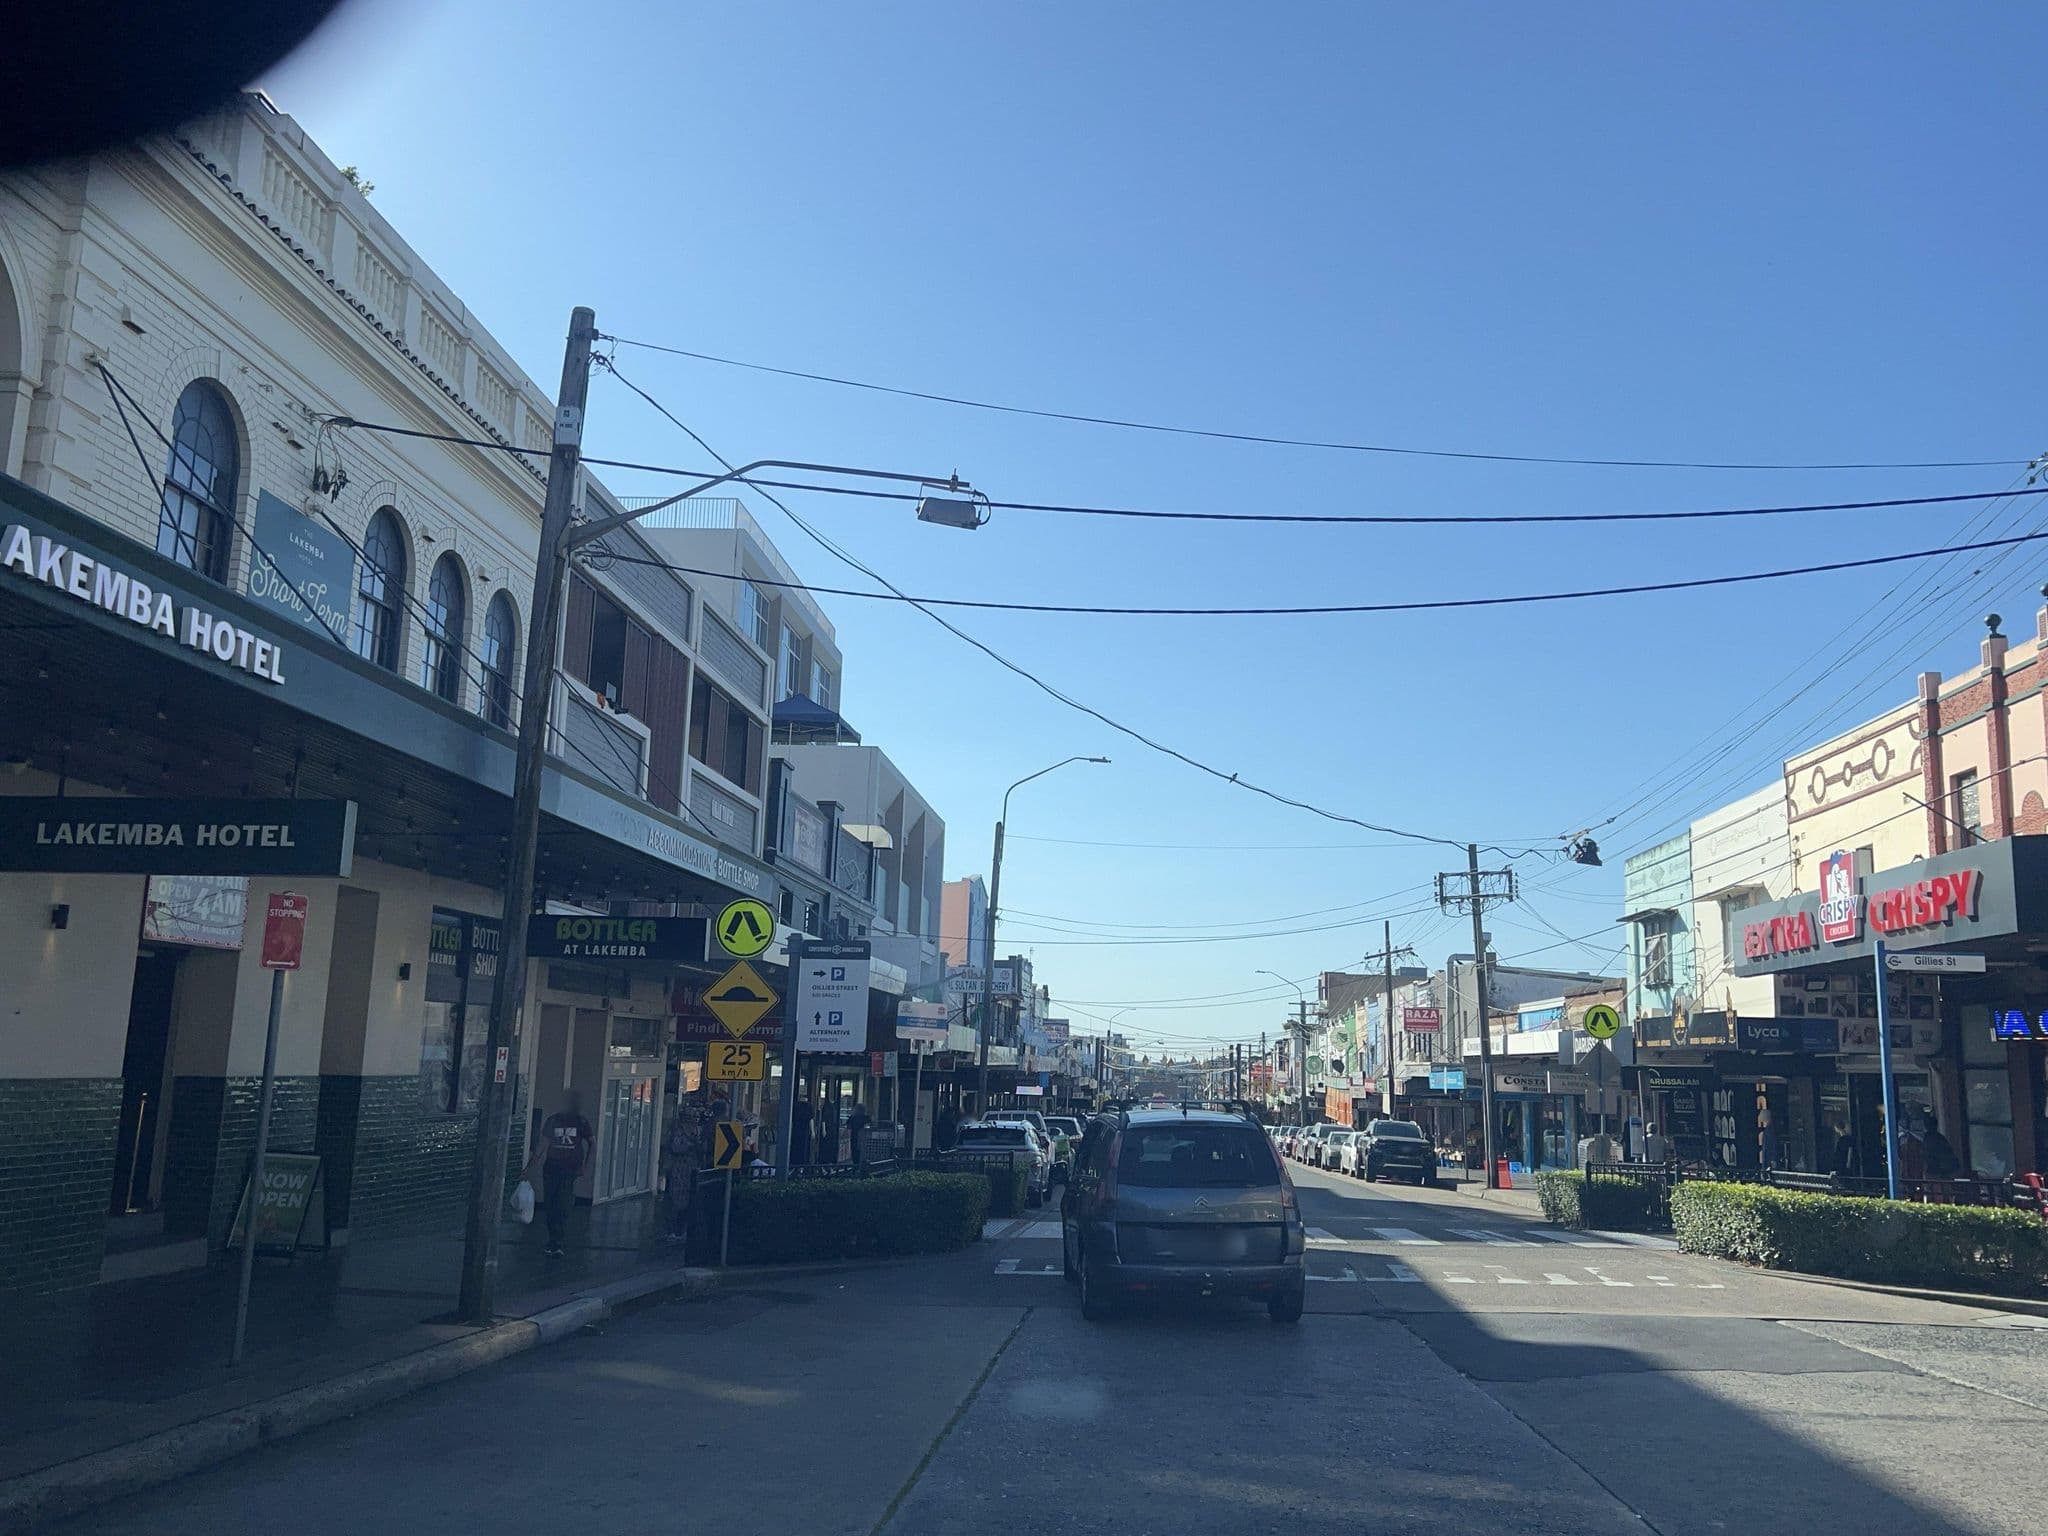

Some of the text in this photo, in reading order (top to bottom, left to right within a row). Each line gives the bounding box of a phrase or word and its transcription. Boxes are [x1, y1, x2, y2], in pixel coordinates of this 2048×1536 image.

[289, 533, 325, 561] LAKEMBA
[250, 551, 347, 634] Short Term
[0, 524, 286, 685] AKEMBA HOTEL
[36, 822, 296, 847] LAKEMBA HOTEL
[647, 827, 760, 891] ACCOMMODATION BOTTLE SHOP
[159, 881, 191, 899] OPEN
[283, 899, 294, 908] NO
[1819, 896, 1858, 924] CRISPY
[1870, 870, 1974, 933] CRISPY
[269, 908, 306, 918] STOPPING
[432, 925, 462, 951] TTLER
[472, 927, 500, 951] BOTTL
[556, 919, 657, 942] BOTTLER
[1744, 911, 1812, 958] EXTRA
[430, 952, 457, 966] AKEMBA
[564, 946, 647, 957] AT LAKEMBA
[1914, 955, 1957, 966] Gillies St
[955, 980, 977, 990] SULTAN
[980, 981, 1010, 992] BCHERY
[1405, 1009, 1438, 1018] RAZA
[1748, 1025, 1780, 1041] Lyca
[723, 1045, 751, 1067] 25
[721, 1067, 749, 1078] km/h
[1503, 1076, 1546, 1087] CONSTA
[1649, 1078, 1700, 1086] ARUSSALAM
[261, 1172, 308, 1190] NOW
[256, 1191, 303, 1208] PEN
